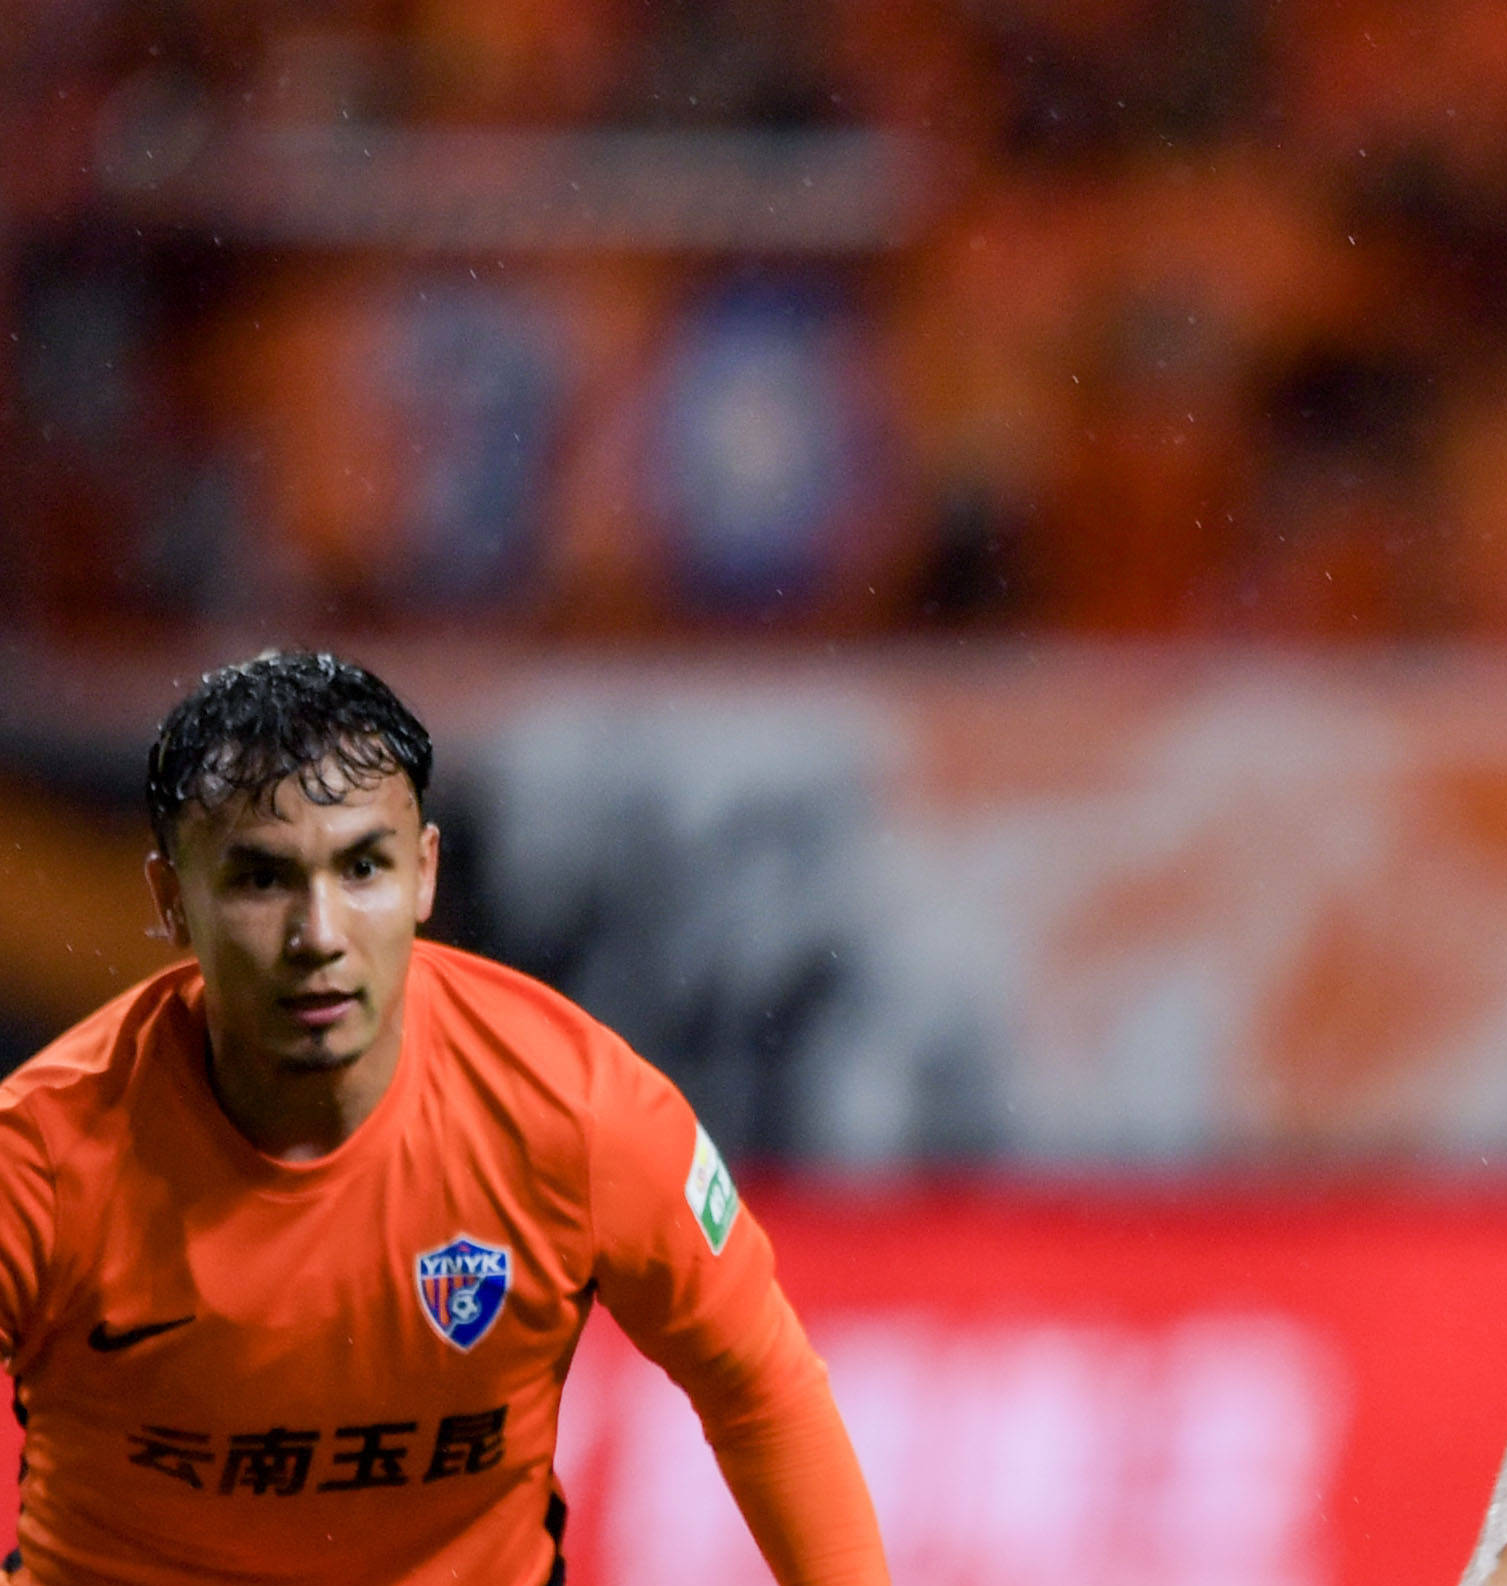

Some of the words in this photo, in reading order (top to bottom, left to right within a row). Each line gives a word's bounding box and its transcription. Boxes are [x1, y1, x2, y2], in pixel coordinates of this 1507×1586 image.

[421, 1253, 501, 1276] YNYK
[126, 1404, 509, 1496] 云南玉昆
